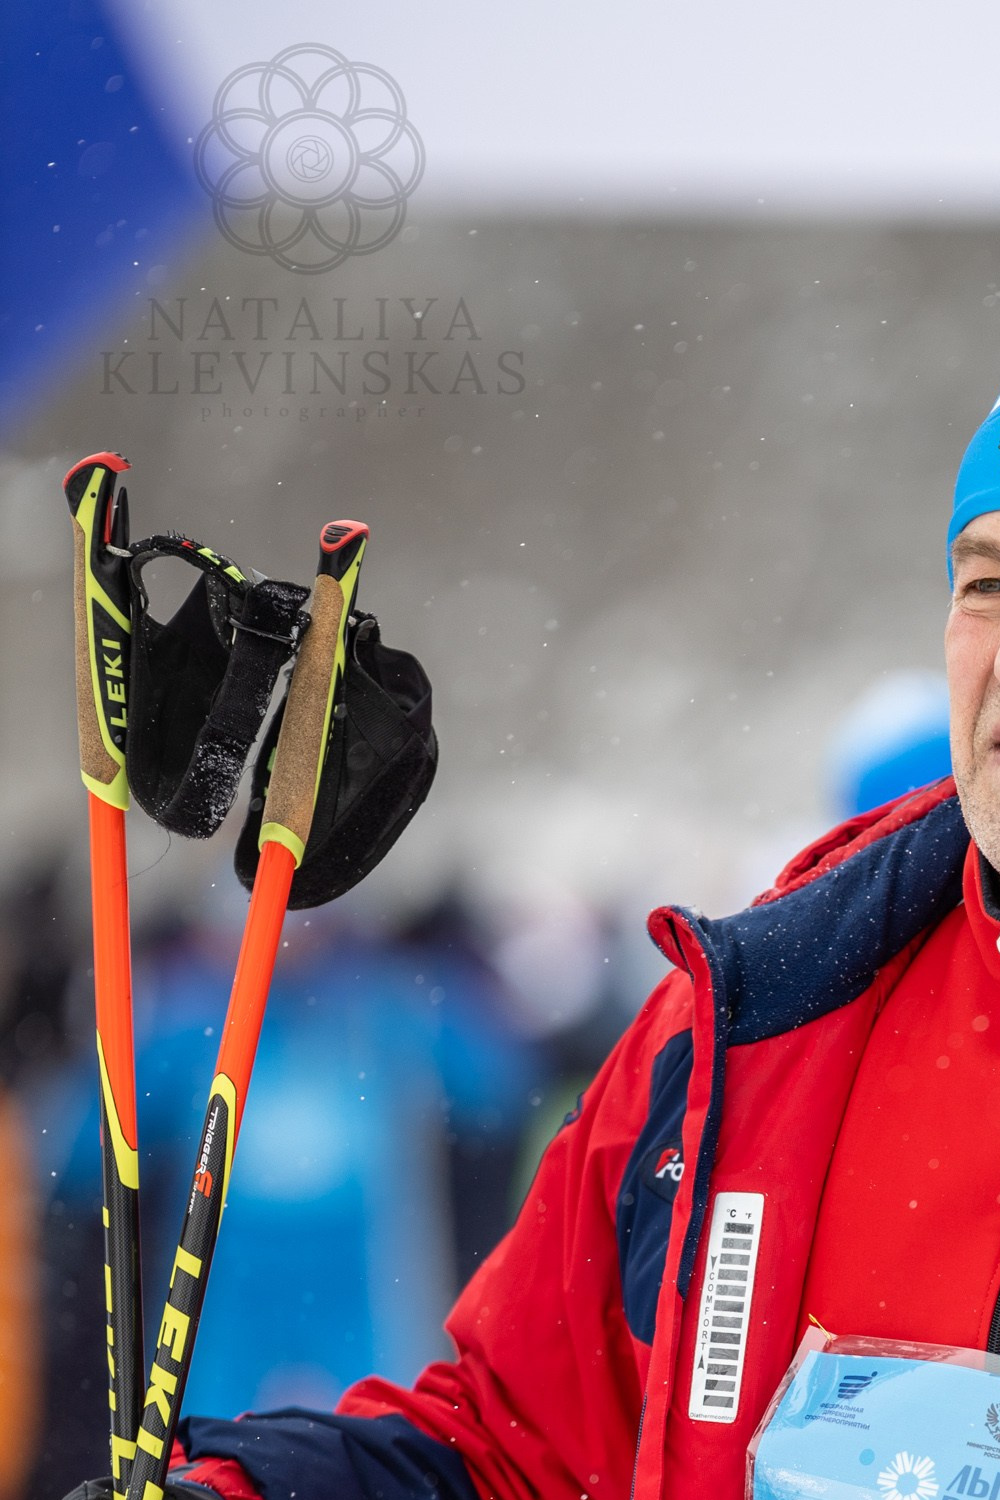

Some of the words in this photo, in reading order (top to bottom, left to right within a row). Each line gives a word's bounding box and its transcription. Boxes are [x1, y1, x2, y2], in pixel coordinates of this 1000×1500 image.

[102, 638, 128, 728] LEKI
[196, 1106, 219, 1174] TRIGGER
[135, 1244, 203, 1460] LEKI
[700, 1272, 715, 1351] COMFORT
